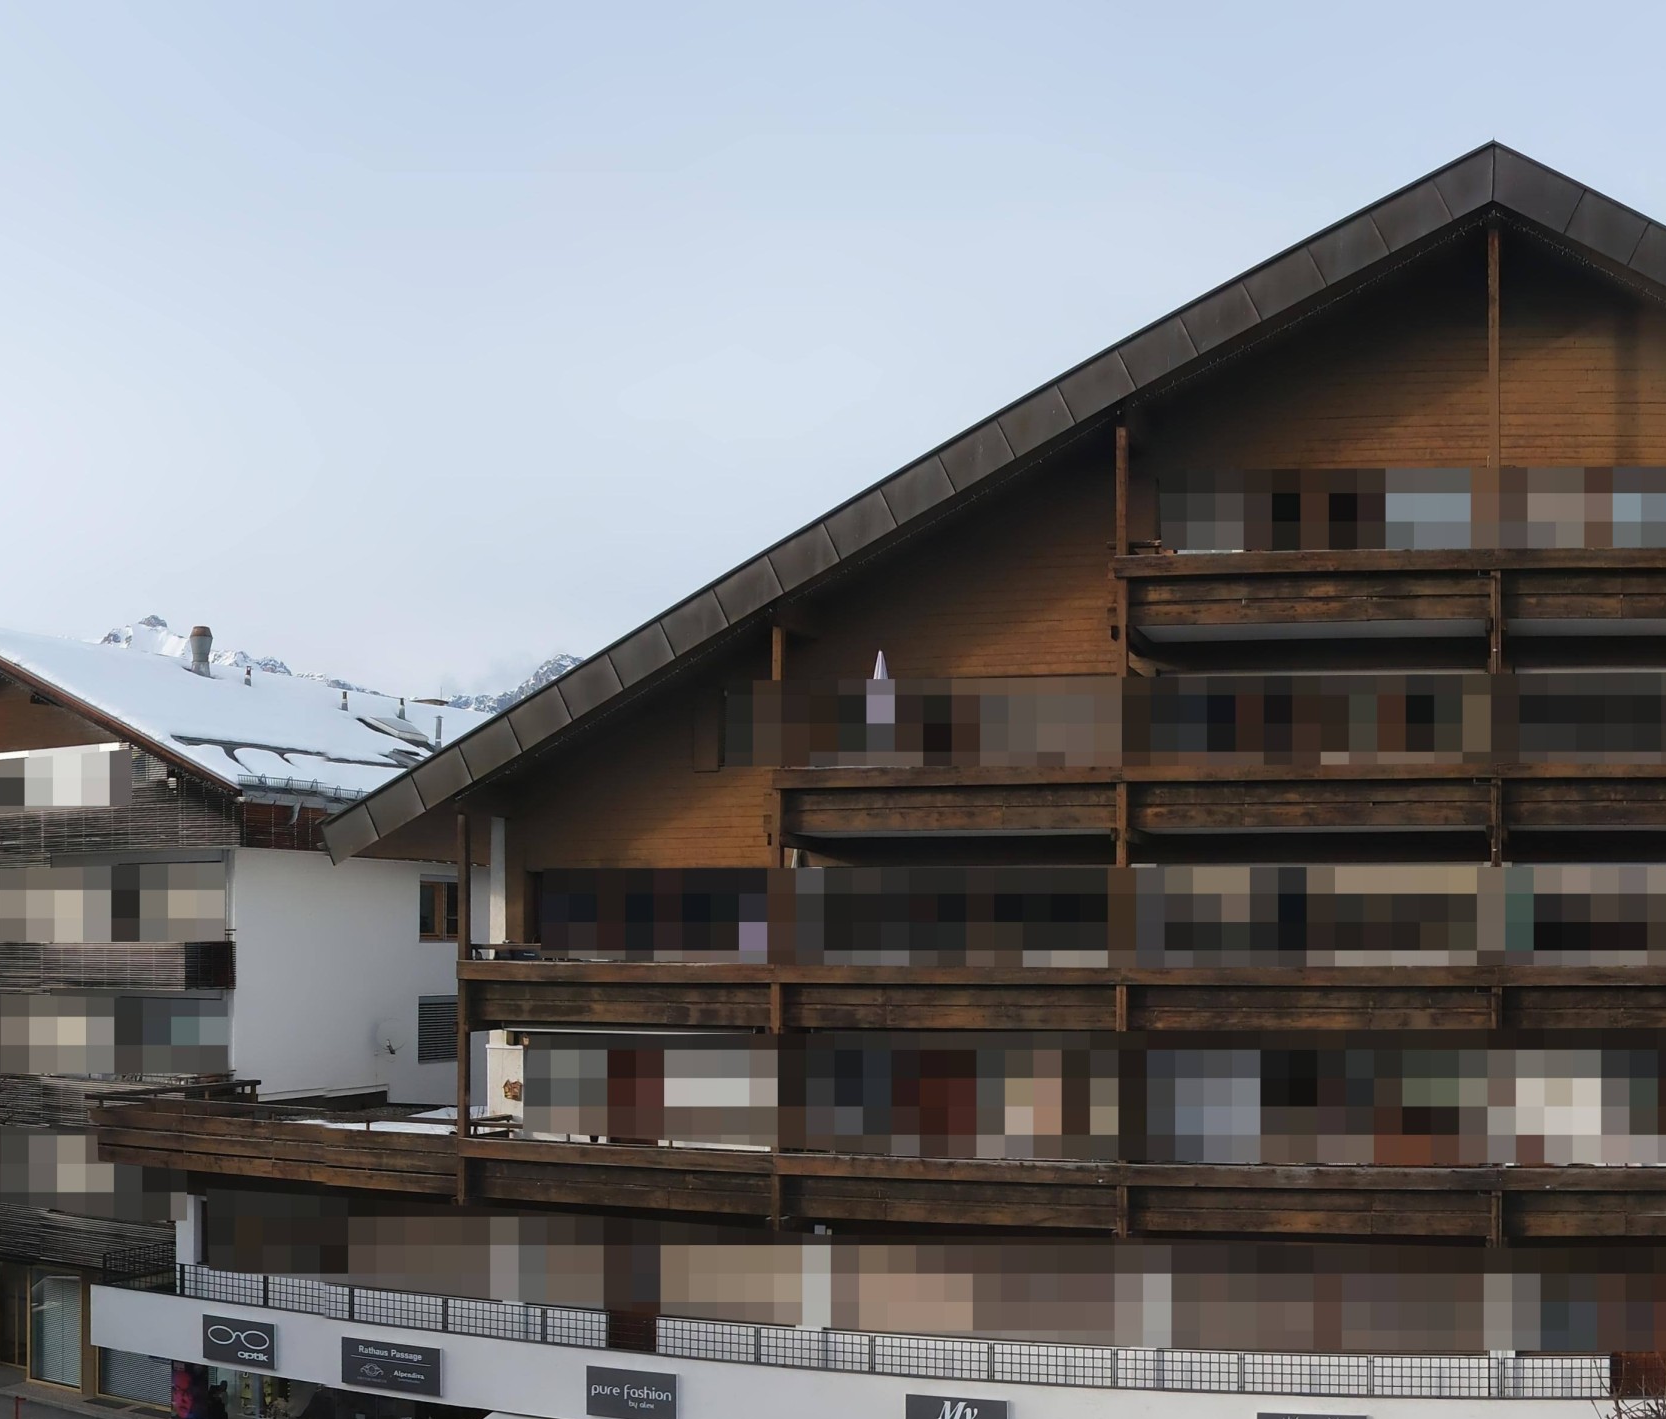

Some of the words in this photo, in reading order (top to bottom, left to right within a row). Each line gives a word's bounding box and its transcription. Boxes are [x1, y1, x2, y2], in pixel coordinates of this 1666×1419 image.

[237, 1351, 268, 1362] optik
[358, 1345, 388, 1356] Rathaus
[390, 1349, 422, 1361] Passage
[393, 1370, 425, 1380] Alpendiva
[591, 1384, 620, 1396] pure
[624, 1384, 672, 1401] fashion
[628, 1400, 638, 1409] by
[639, 1401, 655, 1409] alex
